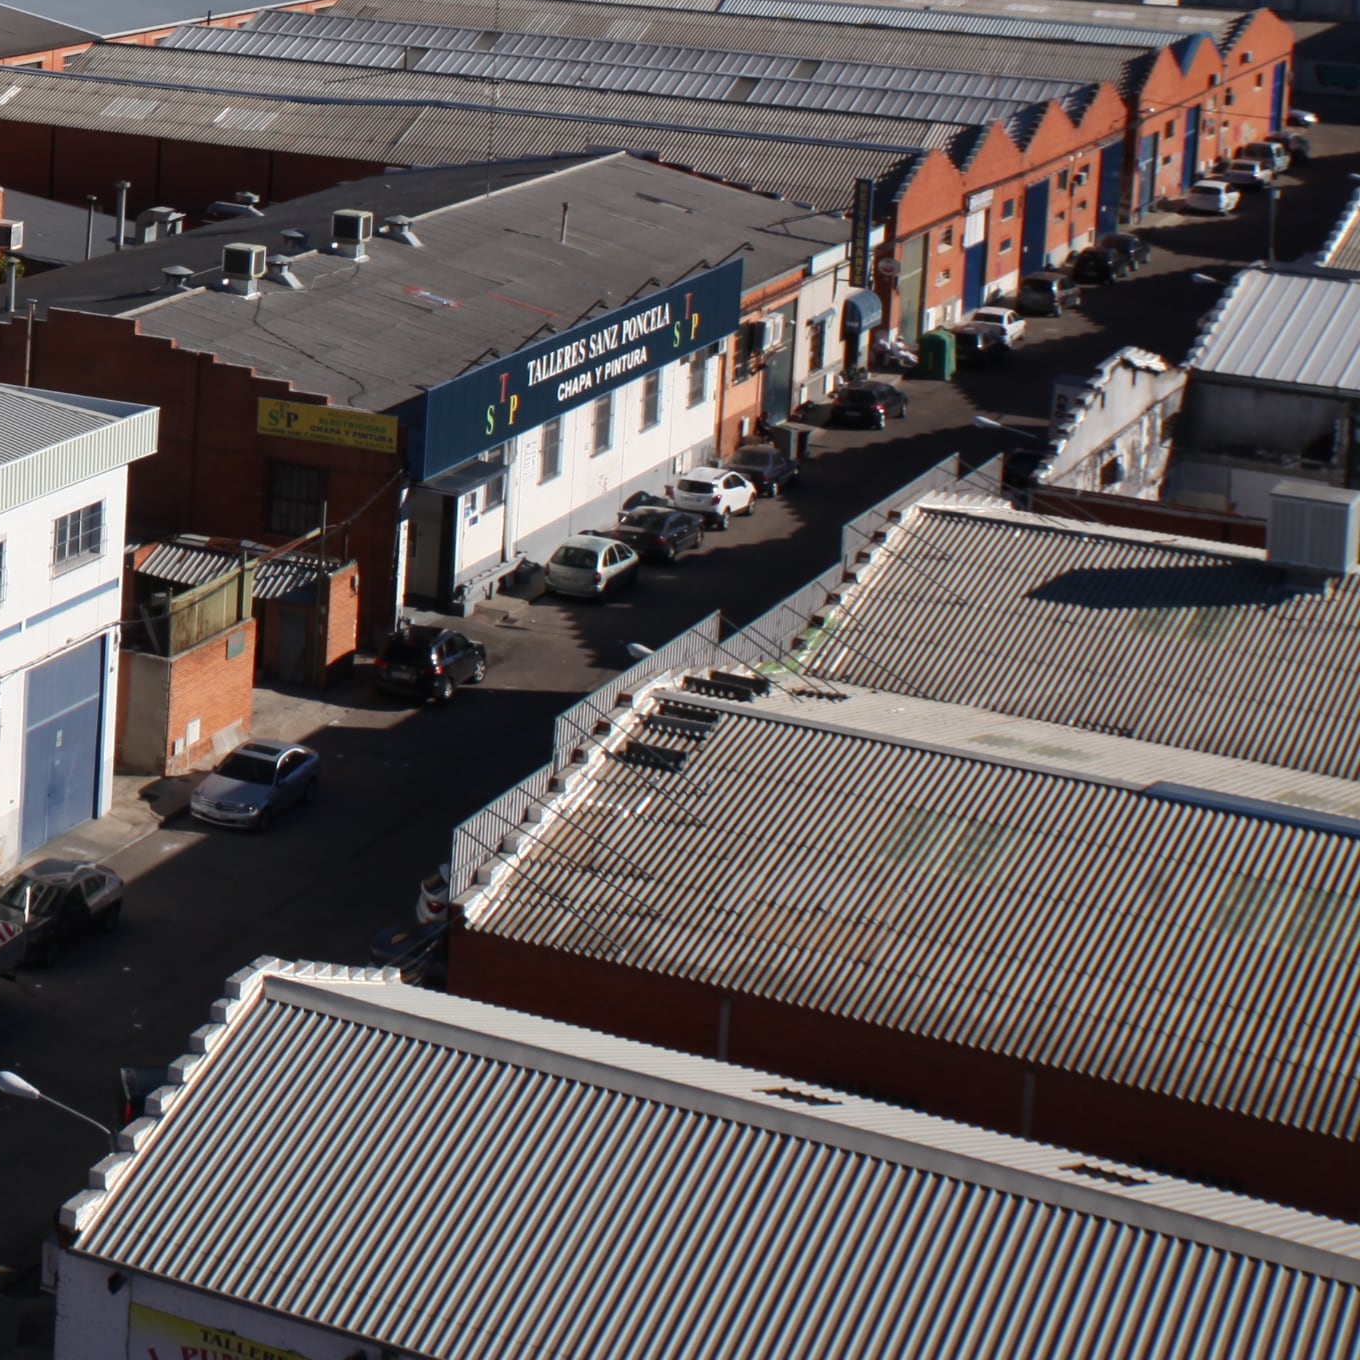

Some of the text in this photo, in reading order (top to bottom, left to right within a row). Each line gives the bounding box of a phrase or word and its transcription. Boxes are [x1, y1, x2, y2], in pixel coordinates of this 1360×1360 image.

[527, 302, 673, 387] TALLERES SANZ PONCELA
[557, 345, 648, 402] CHAPA Y PINTURA
